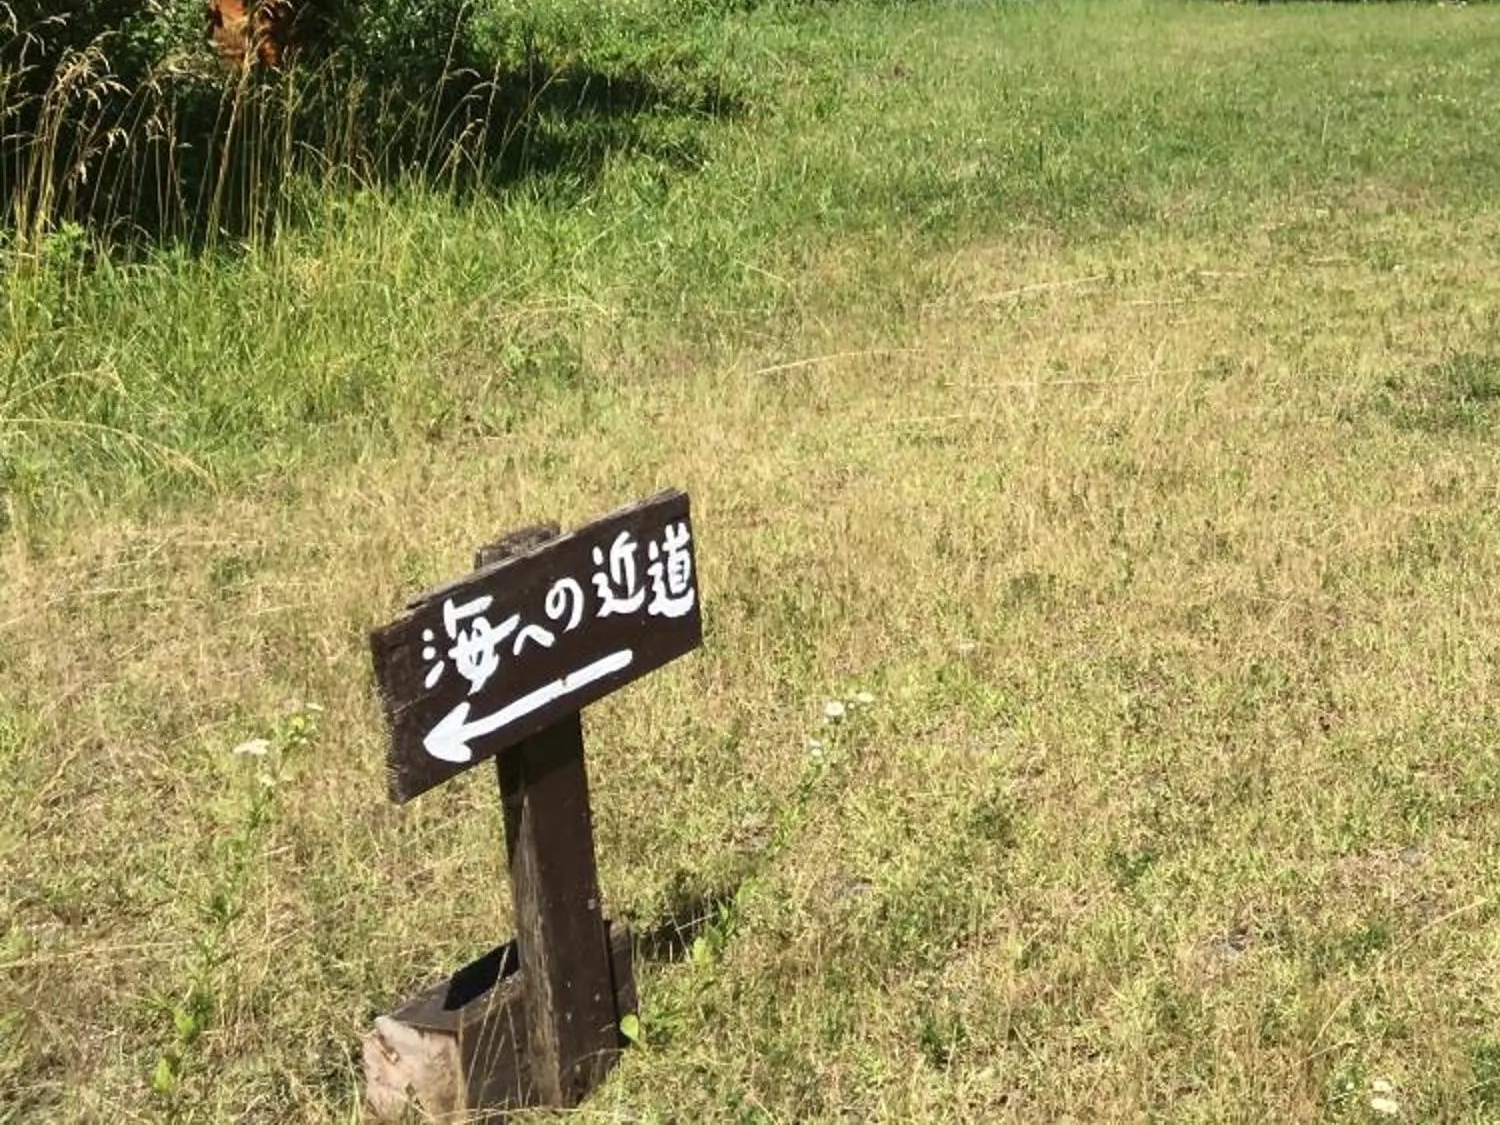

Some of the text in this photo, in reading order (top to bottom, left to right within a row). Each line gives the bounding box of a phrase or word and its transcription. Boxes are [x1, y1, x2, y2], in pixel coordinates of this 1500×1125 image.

[422, 522, 695, 695] 海への近道
